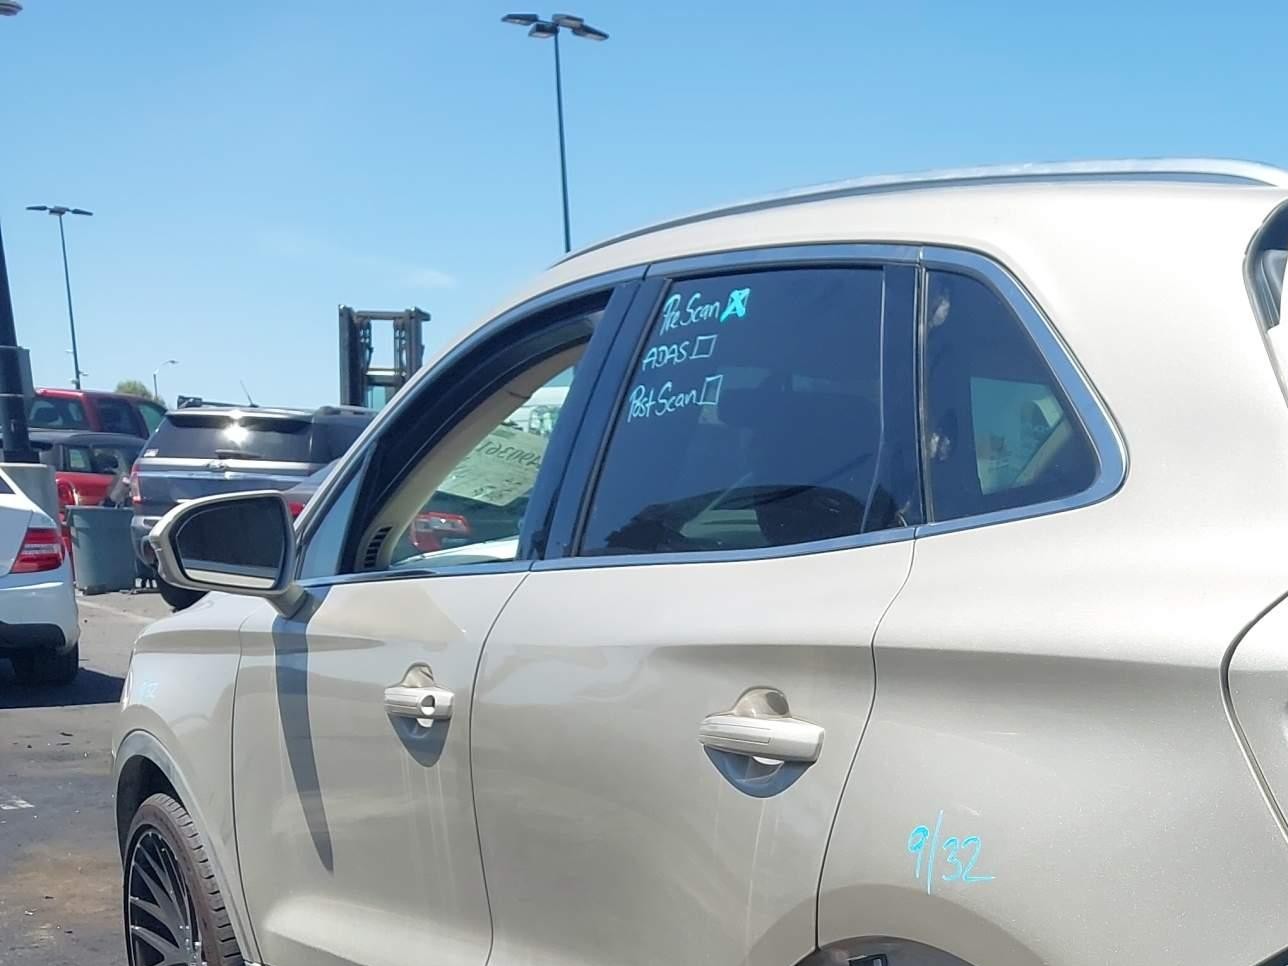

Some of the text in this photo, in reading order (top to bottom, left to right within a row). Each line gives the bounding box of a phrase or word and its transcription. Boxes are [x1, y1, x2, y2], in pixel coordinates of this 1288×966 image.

[660, 292, 720, 336] Pre Scan
[642, 341, 690, 371] ADAS
[627, 380, 697, 422] Post Scan
[907, 809, 997, 896] 9/32
